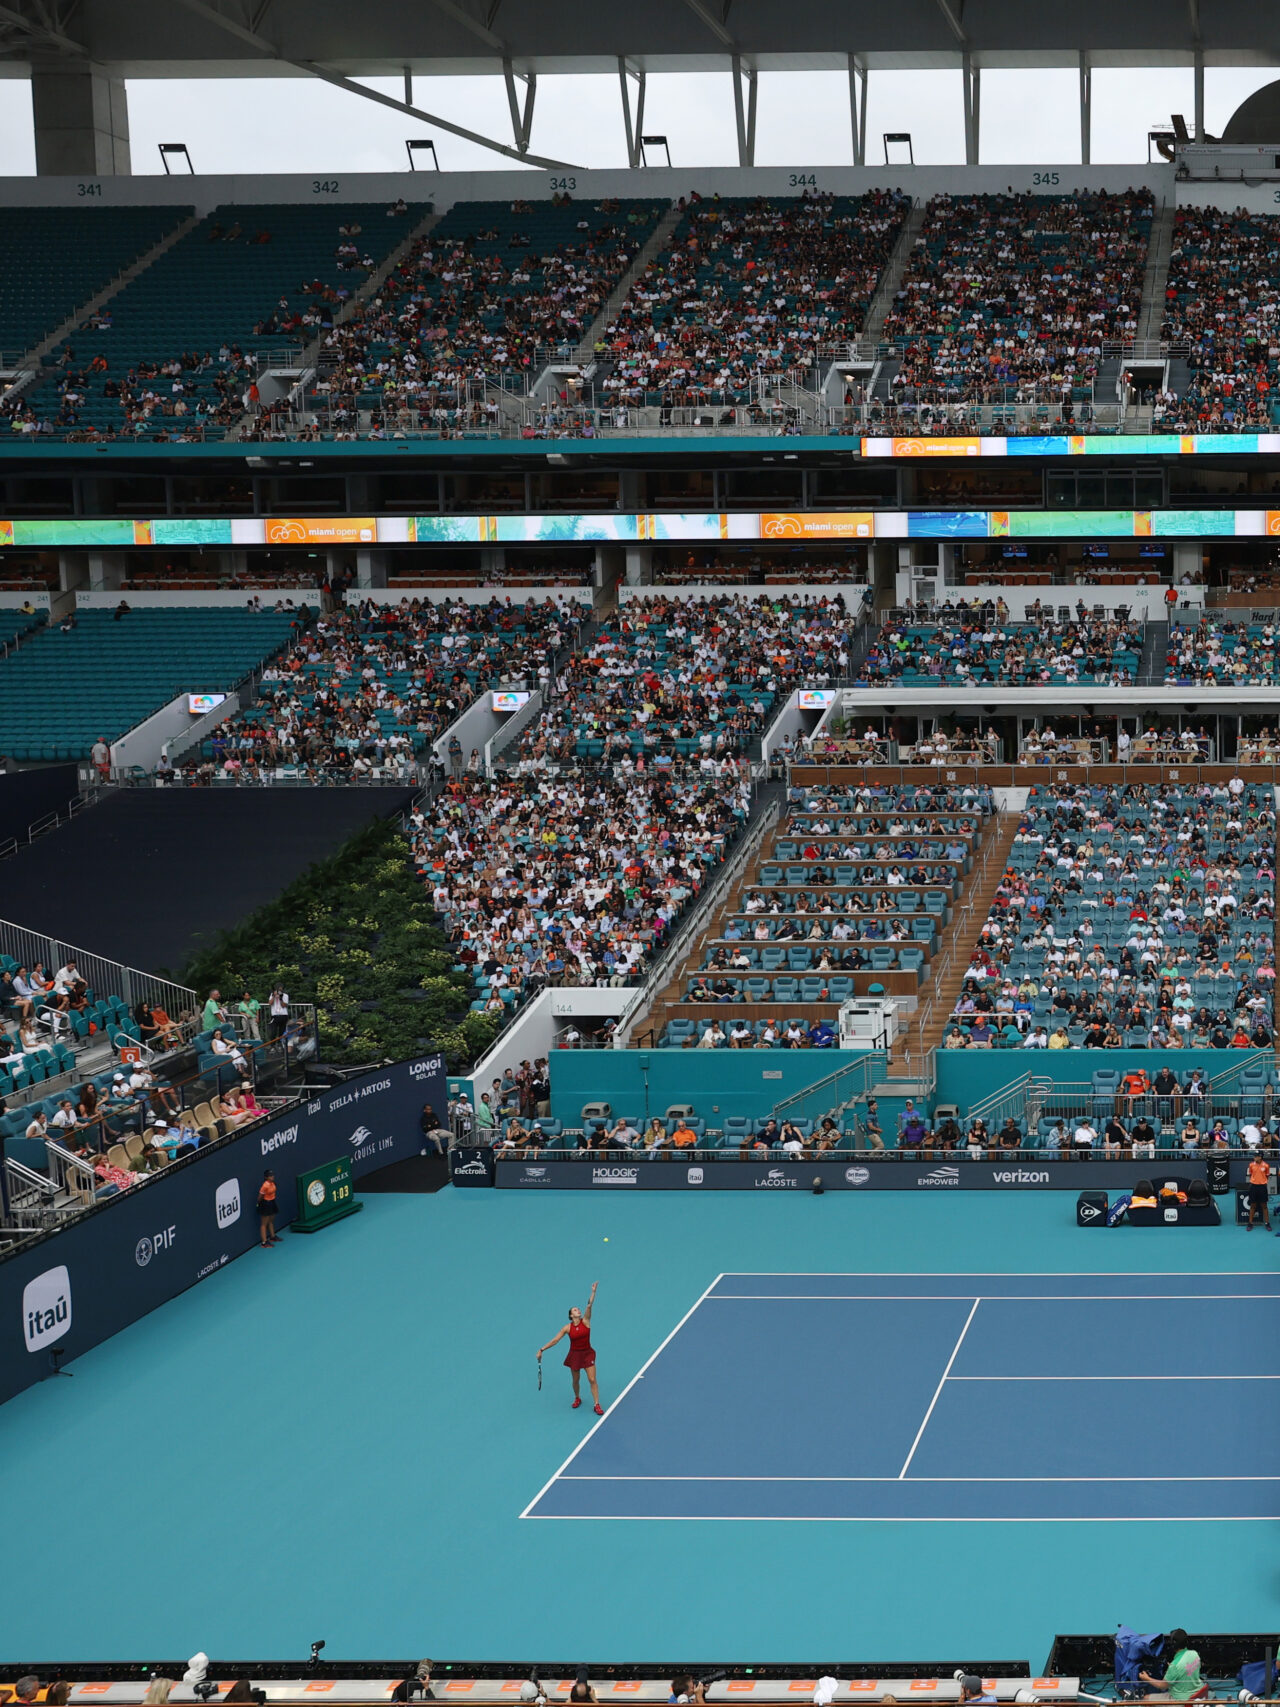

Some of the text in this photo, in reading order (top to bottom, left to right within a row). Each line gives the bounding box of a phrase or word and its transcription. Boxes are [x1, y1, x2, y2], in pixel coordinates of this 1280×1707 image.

[550, 178, 577, 190] 343
[789, 174, 817, 187] 344
[1032, 173, 1060, 186] 345
[77, 184, 103, 196] 341
[312, 181, 340, 194] 342
[336, 529, 357, 537] open
[833, 524, 854, 532] open
[1252, 612, 1274, 621] Hard
[556, 1004, 573, 1013] 144
[126, 1053, 135, 1062] Q
[415, 1070, 437, 1081] SOLAR
[330, 1079, 391, 1112] STELLA ARTOIS
[307, 1098, 321, 1116] itaú
[261, 1124, 298, 1155] betway
[354, 1136, 393, 1161] CRUISE LINE
[458, 1151, 482, 1159] 1 2
[330, 1172, 349, 1184] ROLEX
[592, 1168, 638, 1177] HOLOGIC
[993, 1168, 1050, 1183] verizon
[755, 1179, 798, 1187] LACOSTE
[332, 1185, 349, 1202] 1:03
[218, 1196, 239, 1221] itaú
[153, 1224, 176, 1255] PIF
[197, 1260, 220, 1279] LACOSTE
[28, 1295, 67, 1340] itaú
